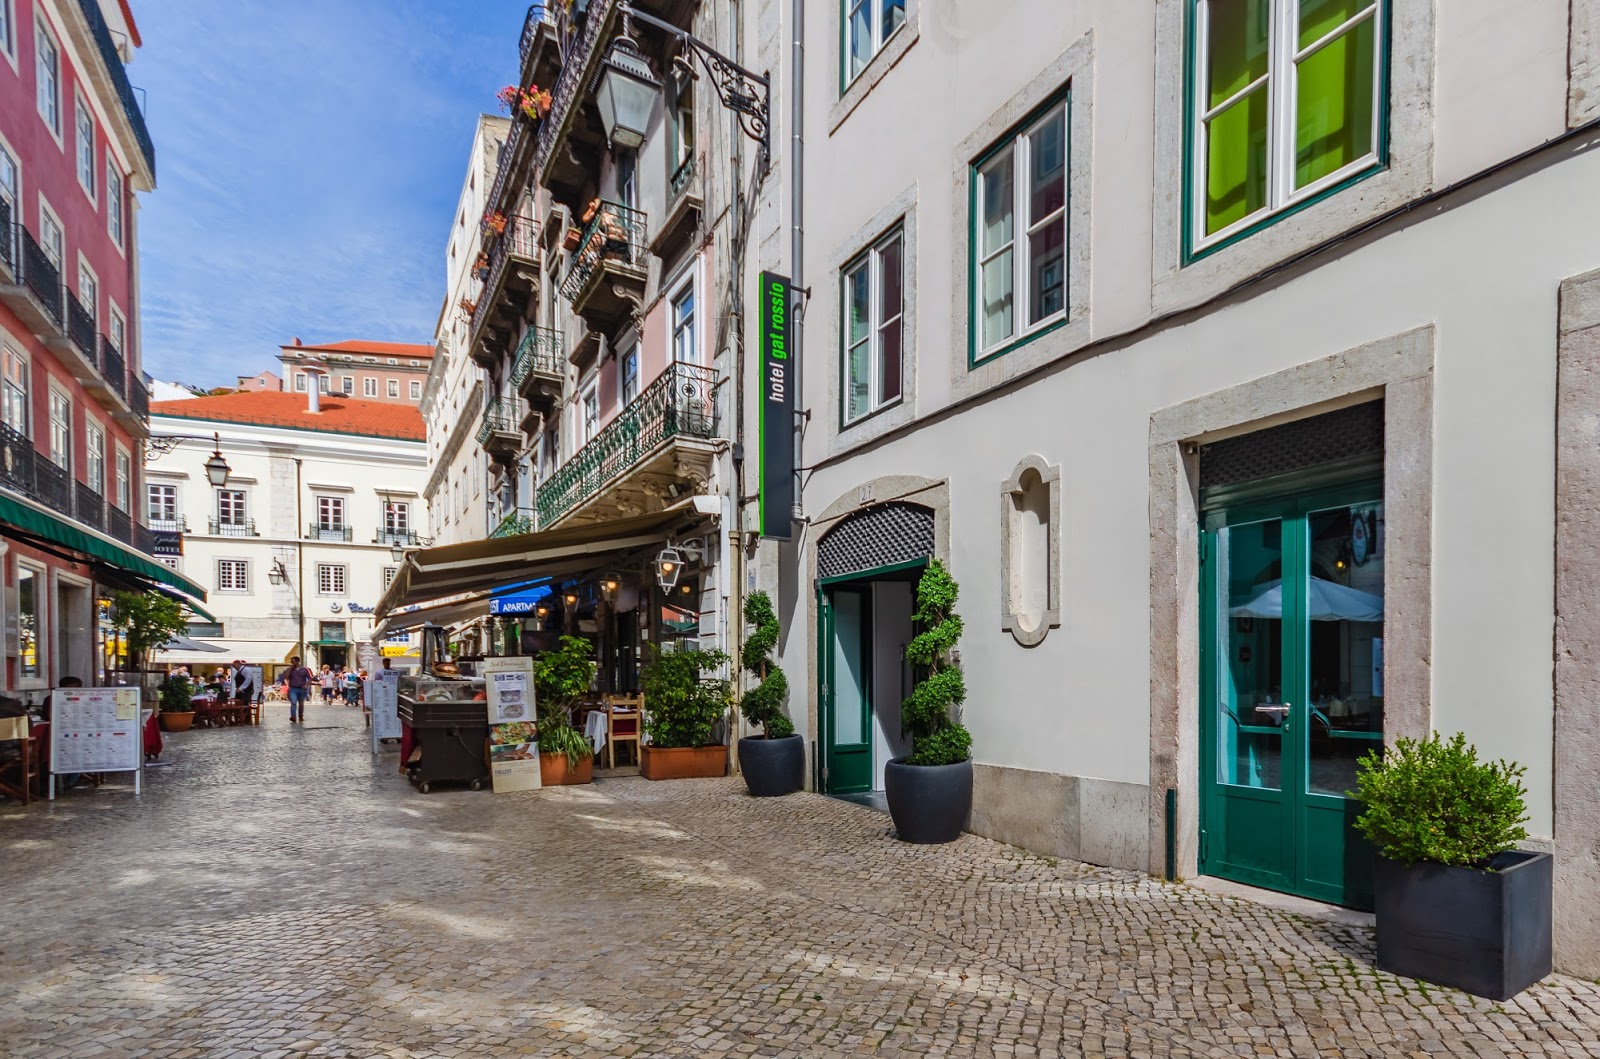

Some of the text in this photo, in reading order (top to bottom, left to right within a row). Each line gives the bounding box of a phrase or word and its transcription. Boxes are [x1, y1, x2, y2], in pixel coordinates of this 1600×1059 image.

[769, 282, 787, 402] hotel gat rossio
